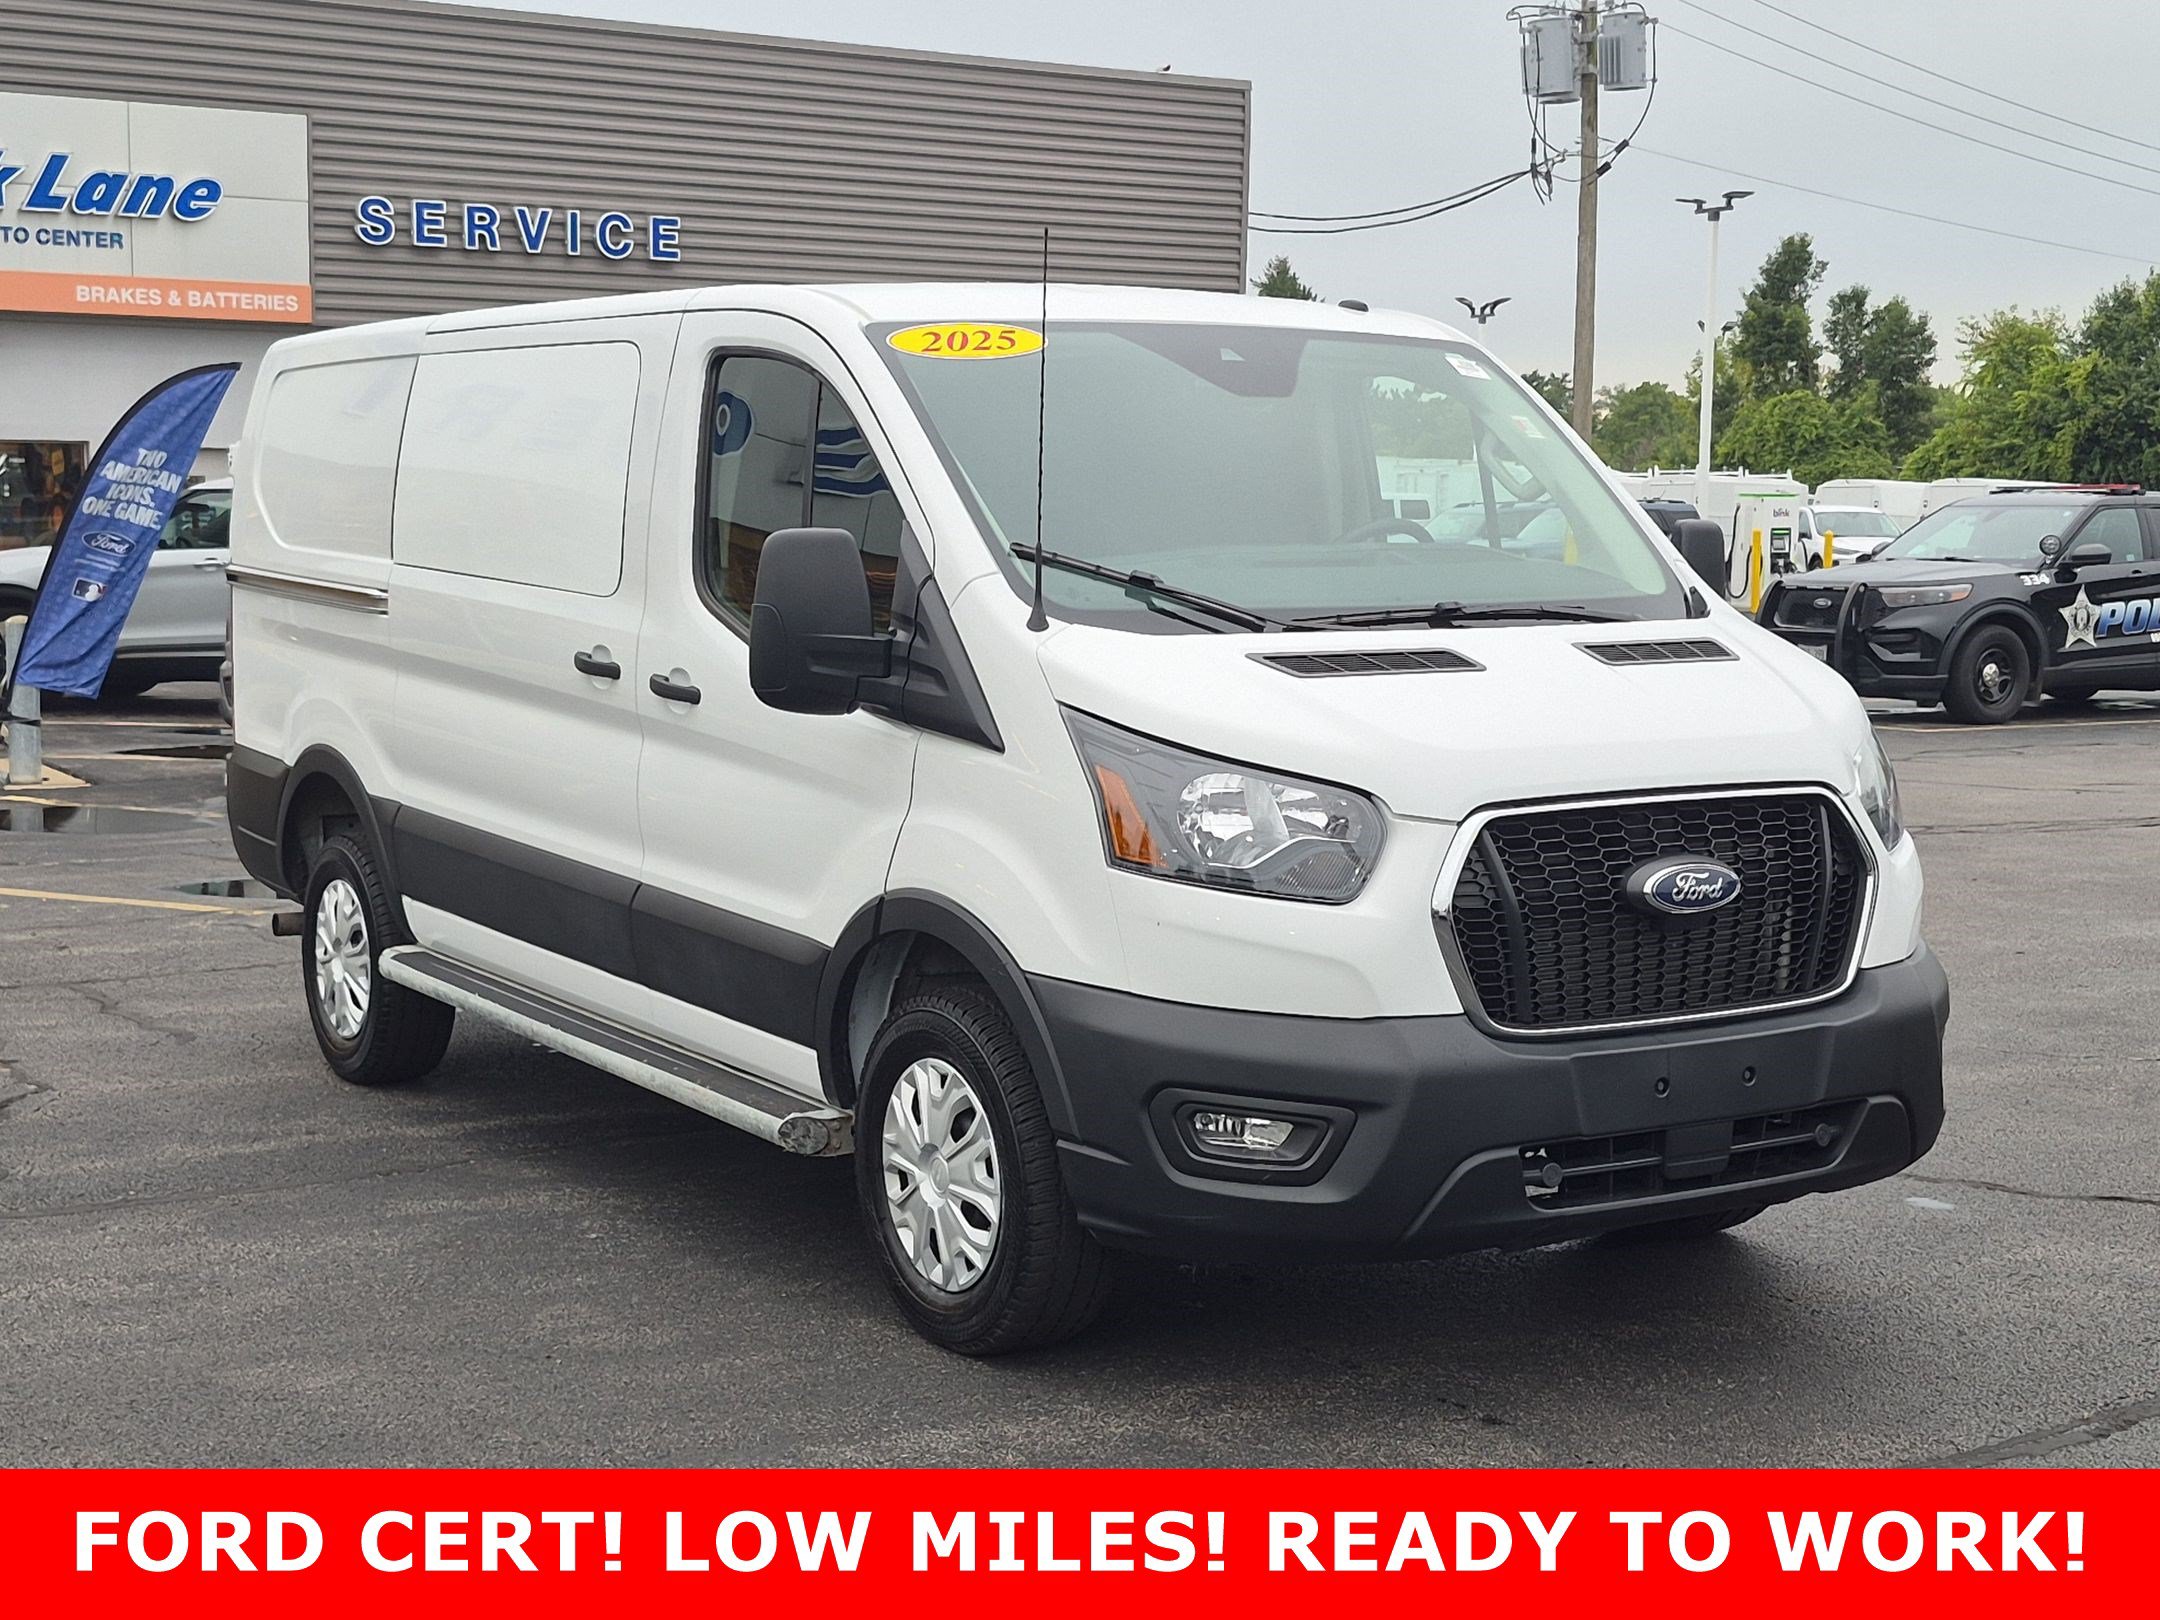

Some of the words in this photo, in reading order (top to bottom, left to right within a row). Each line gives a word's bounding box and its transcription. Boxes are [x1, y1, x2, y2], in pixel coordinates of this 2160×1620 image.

[21, 152, 224, 222] Lane
[35, 228, 125, 250] CENTER
[355, 195, 681, 262] SERVICE
[76, 284, 163, 306] BRAKES
[167, 290, 182, 307] &
[187, 292, 299, 313] BATTERIES
[920, 330, 1016, 352] 2025
[136, 448, 168, 468] TWO
[100, 460, 183, 494] AMERICAN
[82, 496, 113, 518] ONE
[90, 533, 130, 554] Ford
[2019, 573, 2051, 586] 334
[1671, 872, 1723, 902] Ford
